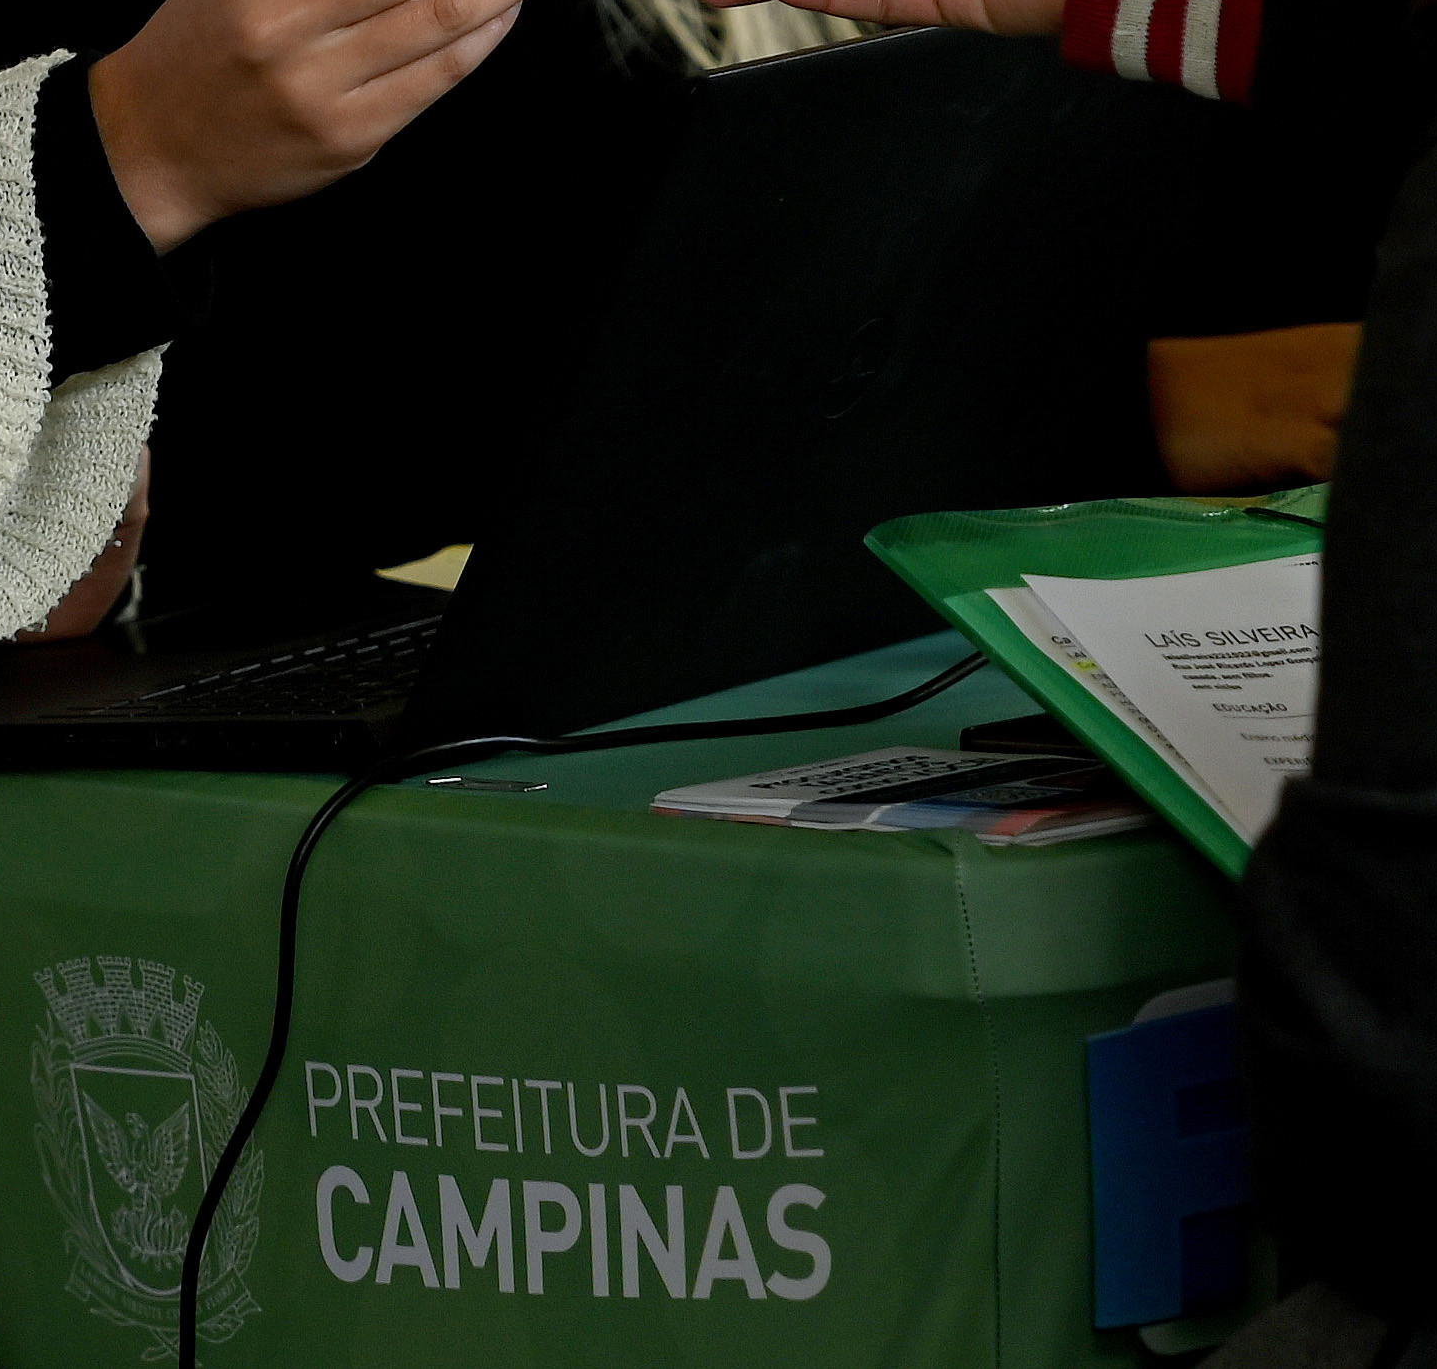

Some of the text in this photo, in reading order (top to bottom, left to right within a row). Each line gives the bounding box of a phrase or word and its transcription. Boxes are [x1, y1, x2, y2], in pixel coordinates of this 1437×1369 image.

[1144, 623, 1320, 649] LAÍS SILVEIRA
[1212, 702, 1288, 714] EDUCAÇÃO
[305, 1060, 825, 1160] PREFEITURA DE
[316, 1164, 833, 1301] CAMPINAS
